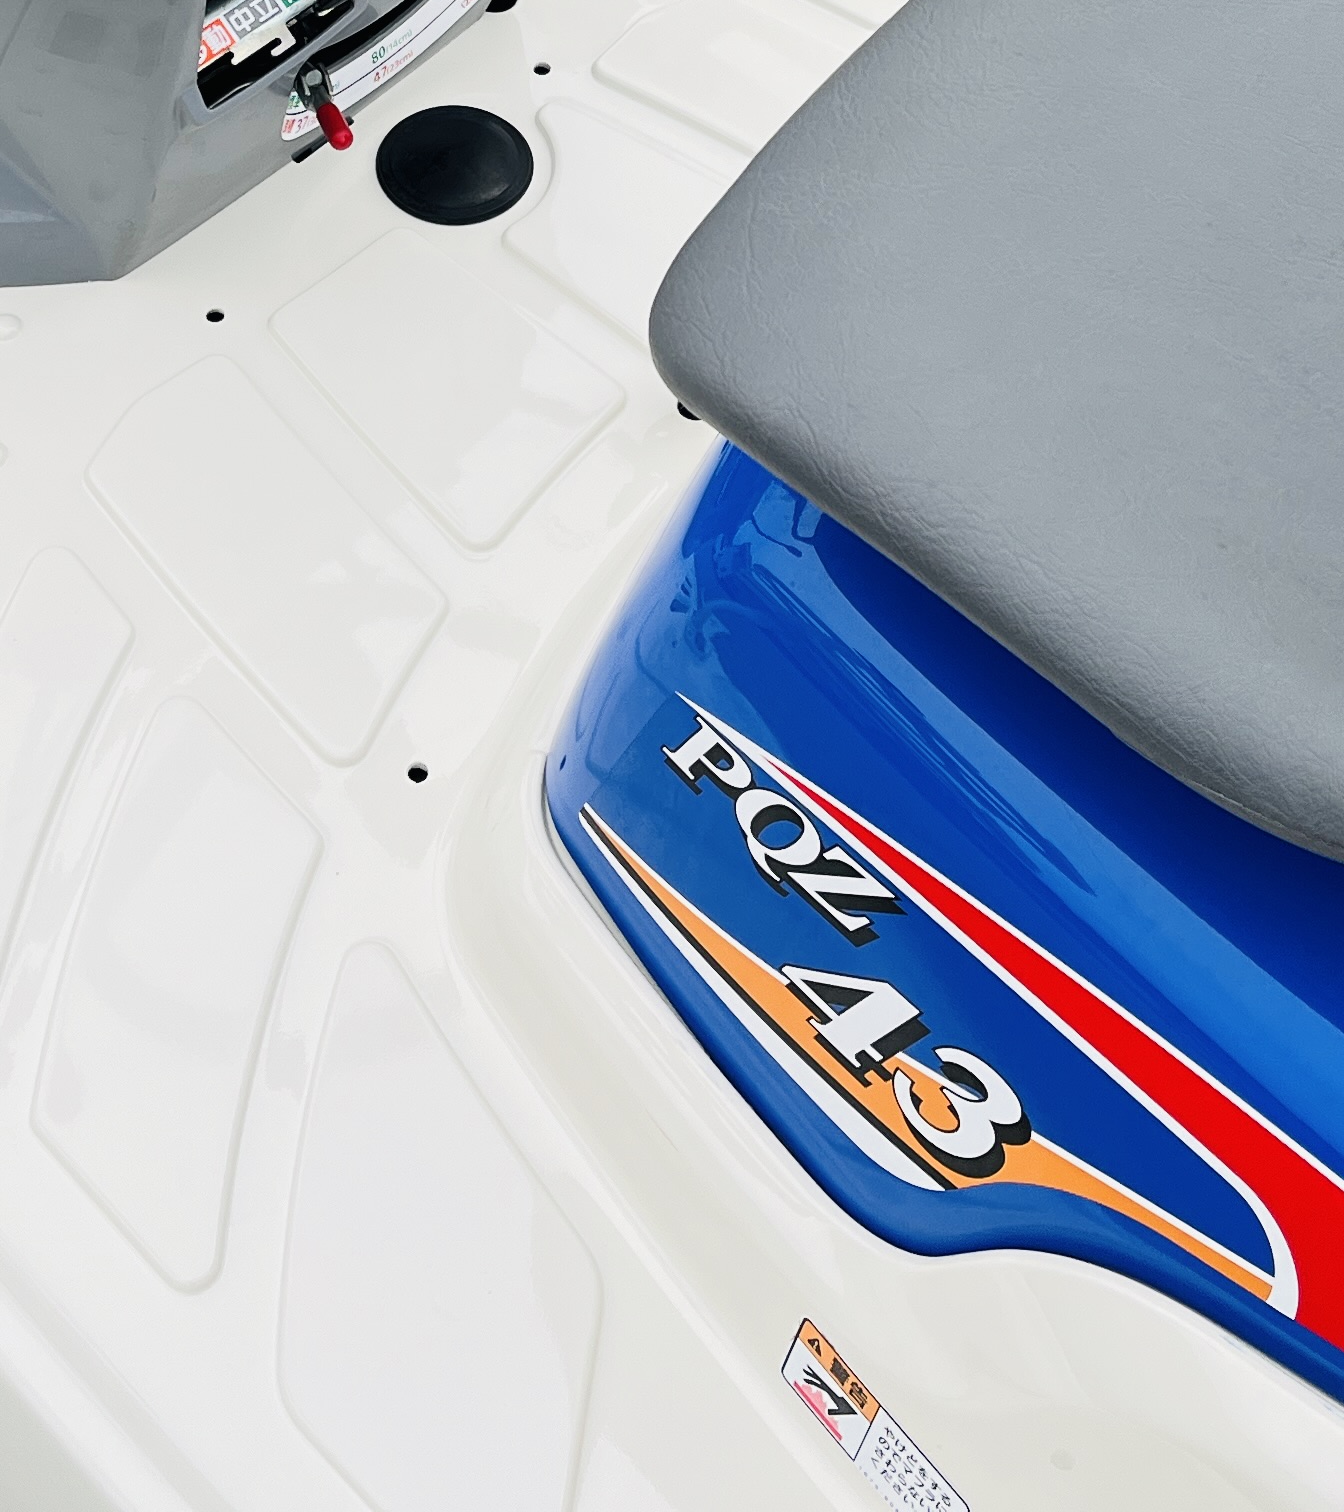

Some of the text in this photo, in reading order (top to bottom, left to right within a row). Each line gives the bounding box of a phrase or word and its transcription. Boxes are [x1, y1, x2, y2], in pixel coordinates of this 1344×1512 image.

[660, 715, 1032, 1178] PQZ 43
[884, 1426, 952, 1508] やけどをする
